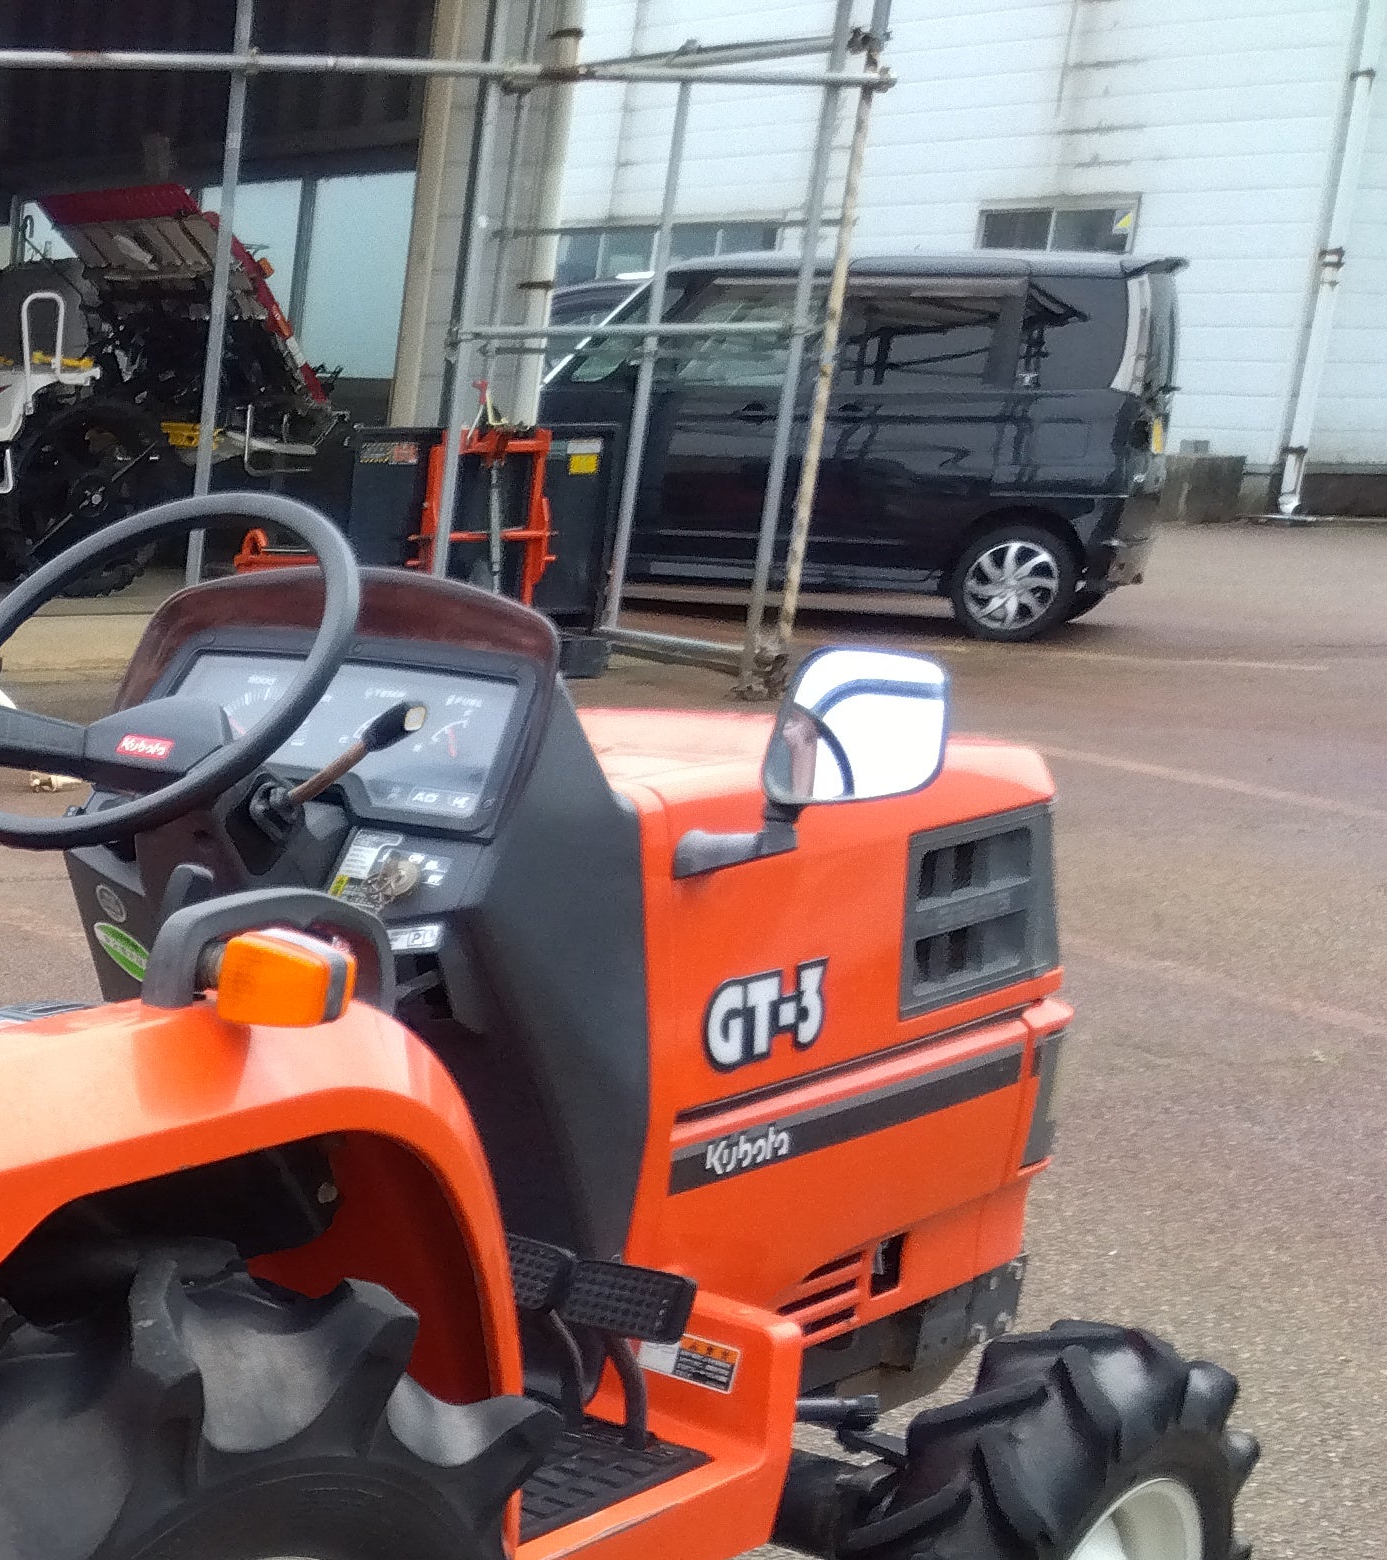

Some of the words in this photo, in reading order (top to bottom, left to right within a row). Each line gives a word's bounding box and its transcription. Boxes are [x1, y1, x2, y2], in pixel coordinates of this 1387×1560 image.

[120, 739, 166, 756] Kubota
[410, 932, 422, 945] P
[705, 1126, 790, 1175] Kubota
